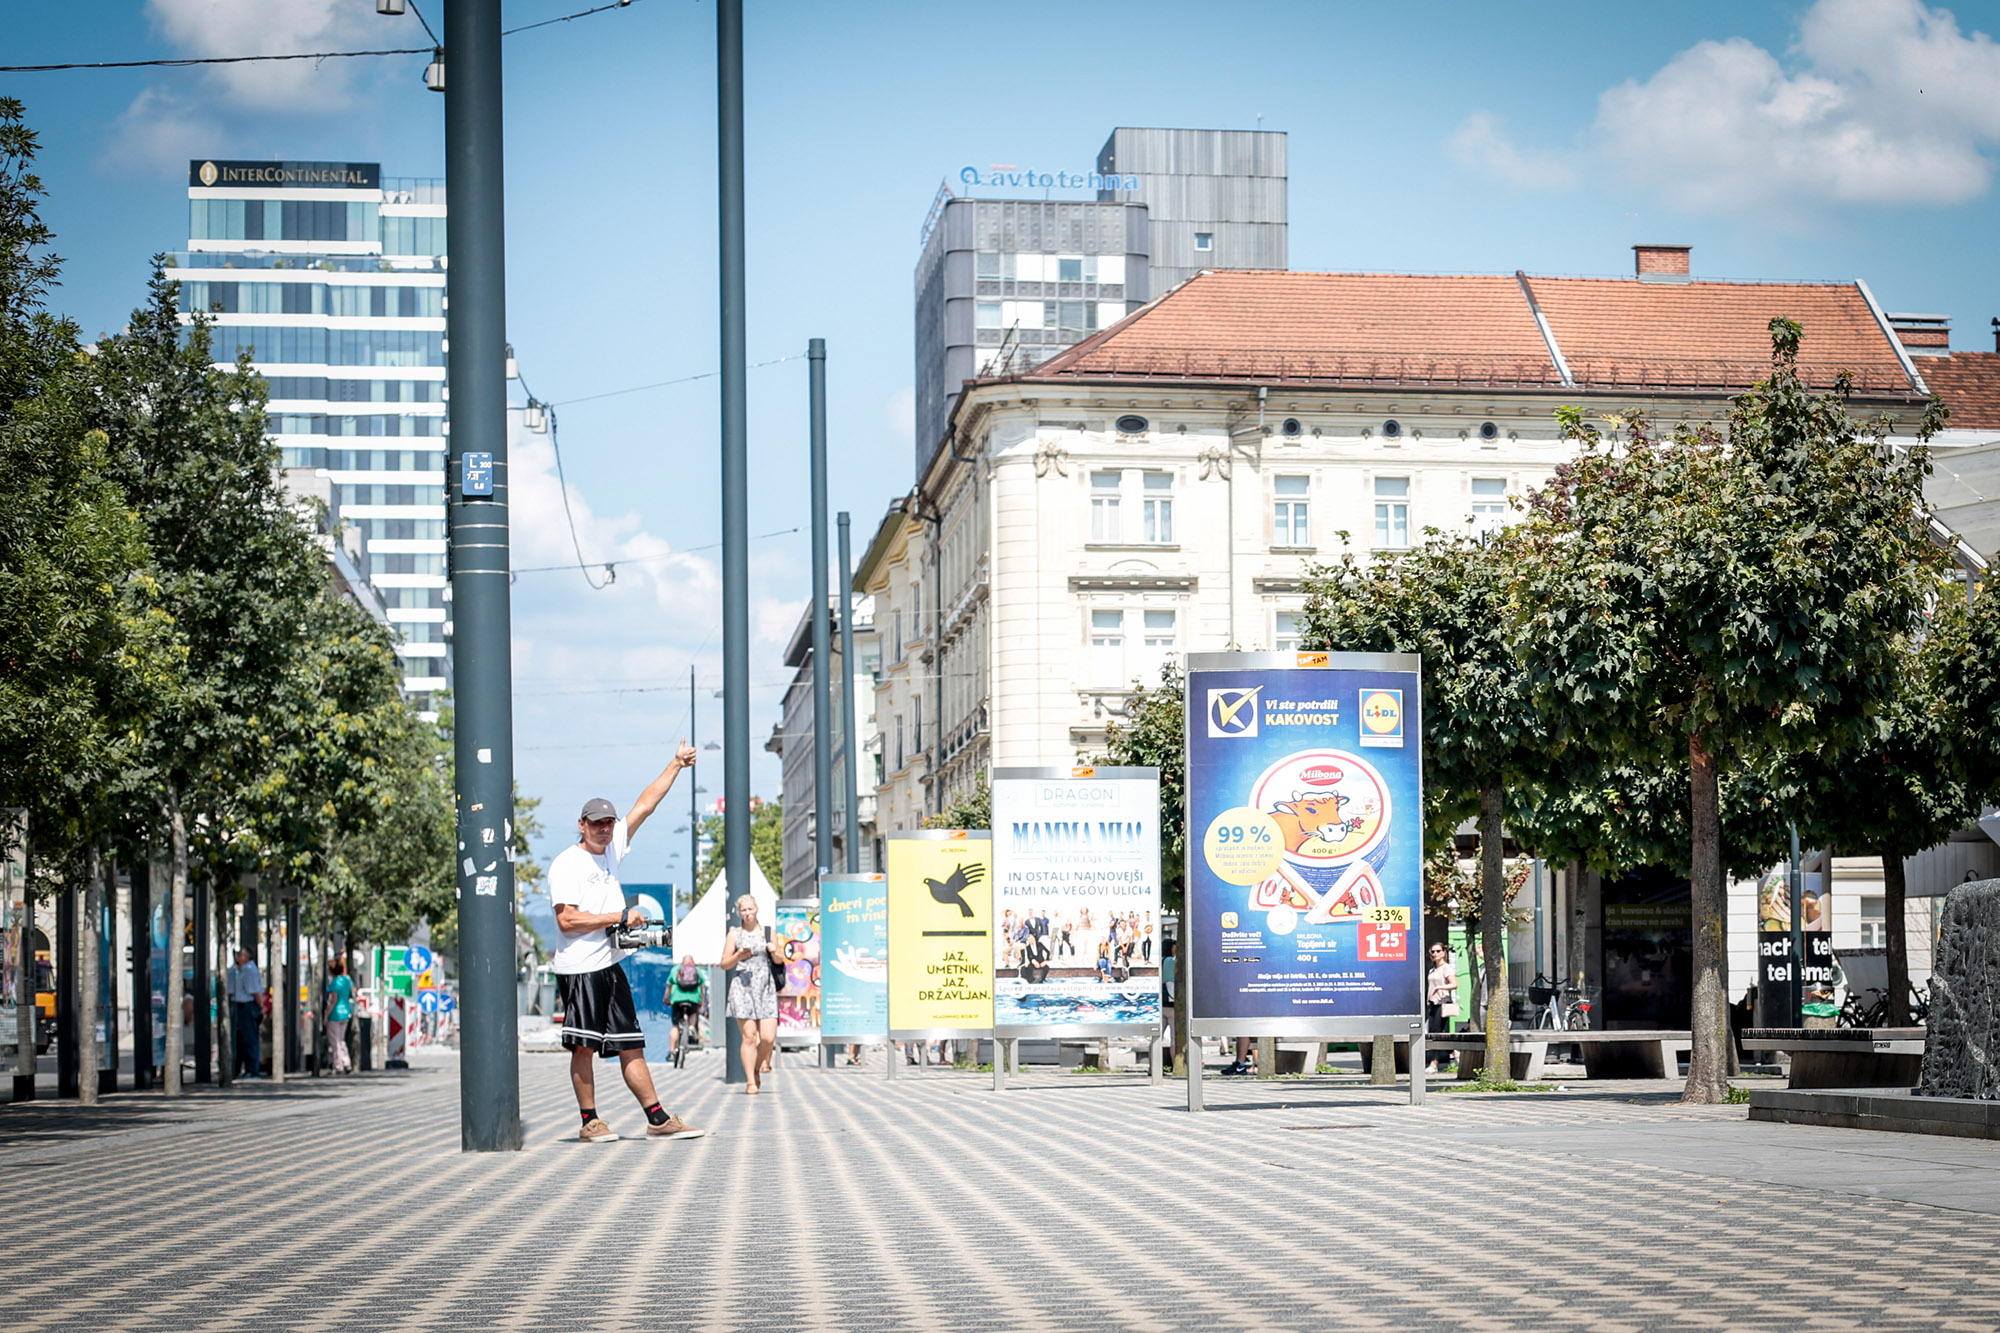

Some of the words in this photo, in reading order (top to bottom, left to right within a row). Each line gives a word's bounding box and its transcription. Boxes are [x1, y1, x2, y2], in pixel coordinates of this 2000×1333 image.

[991, 169, 1139, 191] avtotehna
[1265, 700, 1277, 710] Vi
[1279, 700, 1295, 710] ste
[1297, 699, 1339, 711] potrdili
[1265, 713, 1340, 726] KAKOVOST
[1301, 769, 1343, 779] Milbona
[1043, 788, 1114, 801] DRAGON
[1012, 822, 1092, 850] MAMMA
[1218, 826, 1244, 843] 99
[1250, 826, 1271, 843] %
[1008, 872, 1022, 882] IN
[1025, 872, 1070, 882] OSTALI
[1074, 869, 1143, 883] NAJNOVEJŠI
[1004, 886, 1036, 896] FILMI
[1041, 886, 1059, 896] NA
[1063, 886, 1109, 896] VEGOVI
[1144, 886, 1151, 895] 4
[828, 897, 863, 913] dnevi
[846, 910, 860, 923] in
[1370, 909, 1403, 921] -33%
[1296, 940, 1326, 949] Topljeni
[942, 951, 968, 962] JAZ,
[1296, 954, 1312, 963] 400
[926, 964, 984, 975] UMETNIK.
[942, 977, 968, 989] JAZ,
[918, 987, 991, 1001] DRŽAVLJAN.
